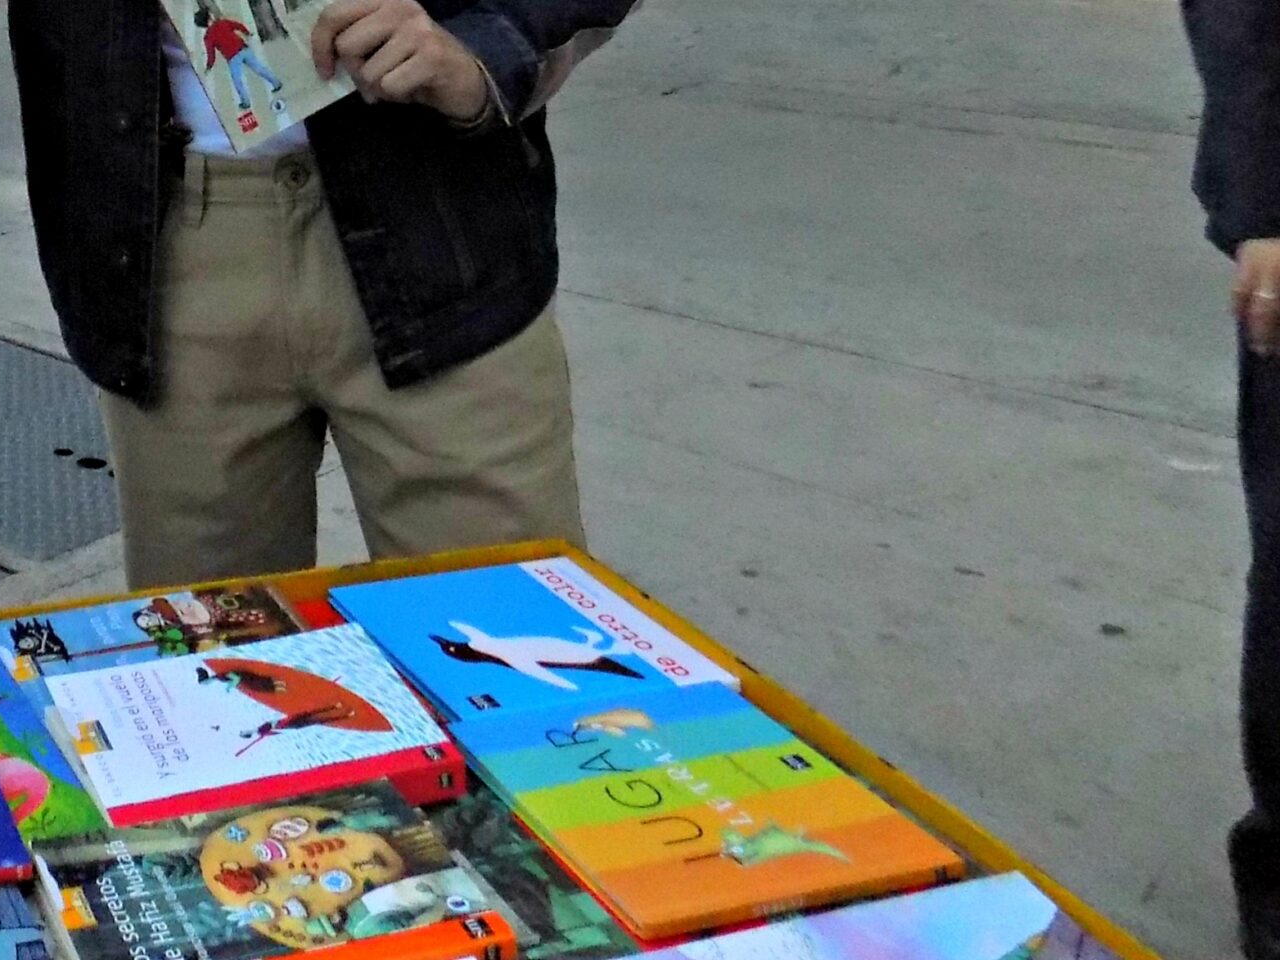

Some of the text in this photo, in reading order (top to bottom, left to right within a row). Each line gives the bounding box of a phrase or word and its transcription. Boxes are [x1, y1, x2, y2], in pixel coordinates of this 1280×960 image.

[534, 567, 690, 678] de otro color
[110, 674, 134, 704] vuelo
[130, 671, 169, 727] mariposas
[123, 704, 140, 716] el
[133, 717, 149, 732] en
[163, 728, 181, 746] las
[172, 747, 190, 763] de
[96, 876, 140, 943] secretos
[139, 899, 175, 945] Hafiz
